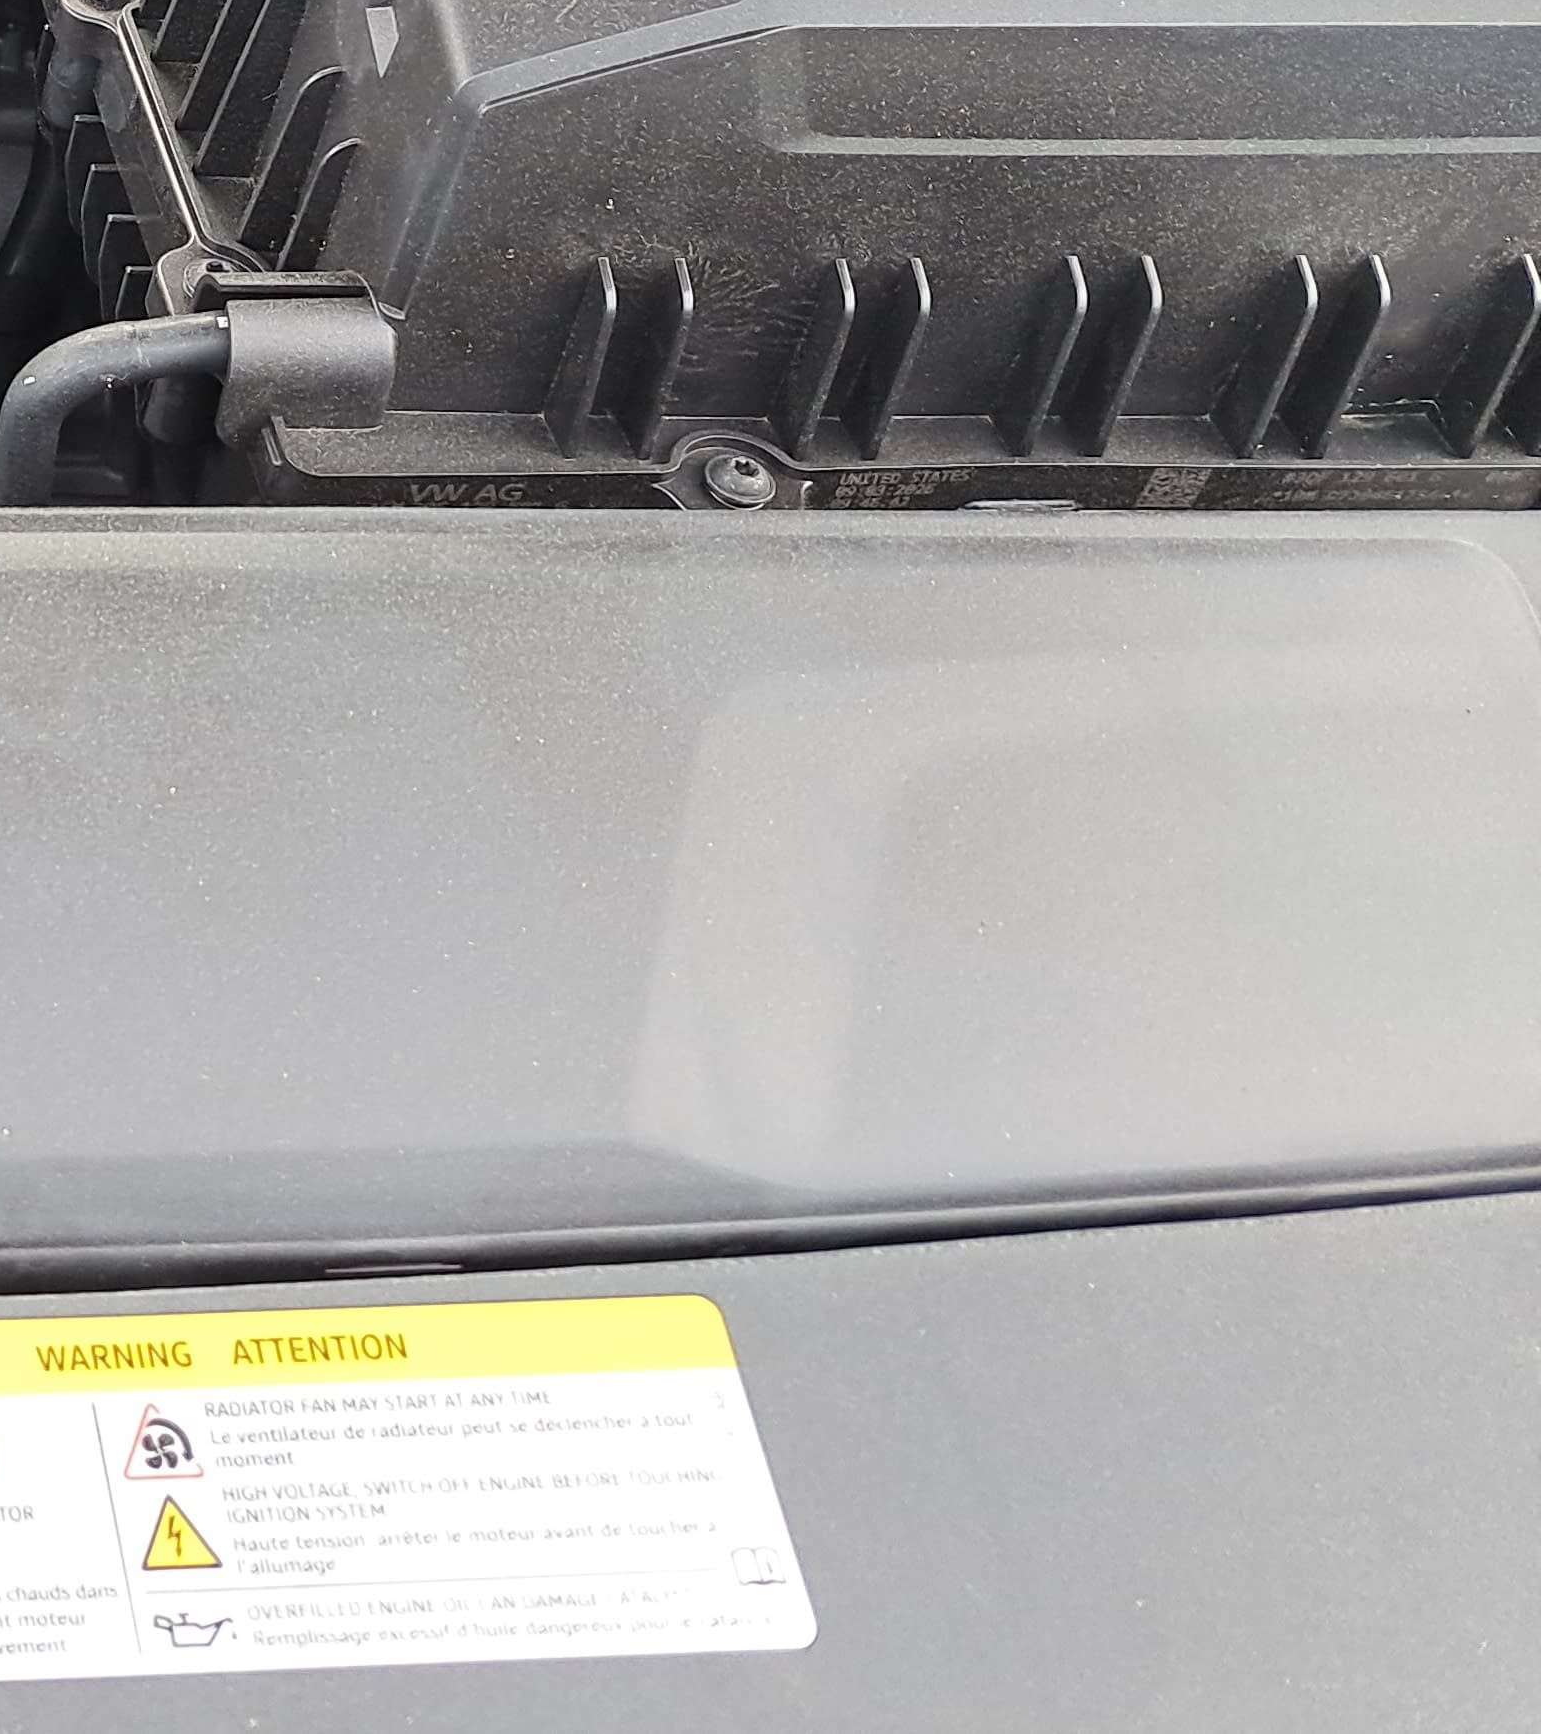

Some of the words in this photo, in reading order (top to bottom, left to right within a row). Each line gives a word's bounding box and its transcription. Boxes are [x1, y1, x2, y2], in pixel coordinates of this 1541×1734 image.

[839, 472, 902, 486] UNITED
[410, 483, 467, 502] VW
[474, 482, 525, 502] AG
[35, 1340, 193, 1372] WARNING
[232, 1333, 408, 1365] ATTENTION
[203, 1399, 296, 1419] RADIATOR
[300, 1397, 338, 1414] FAN
[341, 1396, 378, 1413] MAY
[383, 1393, 437, 1411] START
[444, 1392, 462, 1408] AT
[469, 1393, 504, 1408] ANY
[510, 1390, 551, 1405] TIME
[209, 1429, 231, 1445] Le
[236, 1425, 336, 1445] ventilateur
[343, 1424, 366, 1441] de
[371, 1422, 454, 1439] radiateur
[460, 1420, 502, 1439] peut
[215, 1451, 294, 1469] moment
[221, 1485, 268, 1503] HIGH
[362, 1479, 433, 1497] SWITCH
[477, 1475, 544, 1492] ENGINE
[226, 1505, 311, 1525] IGNITION
[315, 1502, 386, 1521] SYSTEM
[232, 1537, 290, 1553] Haute
[445, 1529, 462, 1544] le
[468, 1528, 535, 1542] moteur
[543, 1524, 594, 1540] avant
[600, 1523, 622, 1538] de
[5, 1585, 72, 1603] chauds
[74, 1583, 119, 1601] dans
[17, 1612, 86, 1628] moteur
